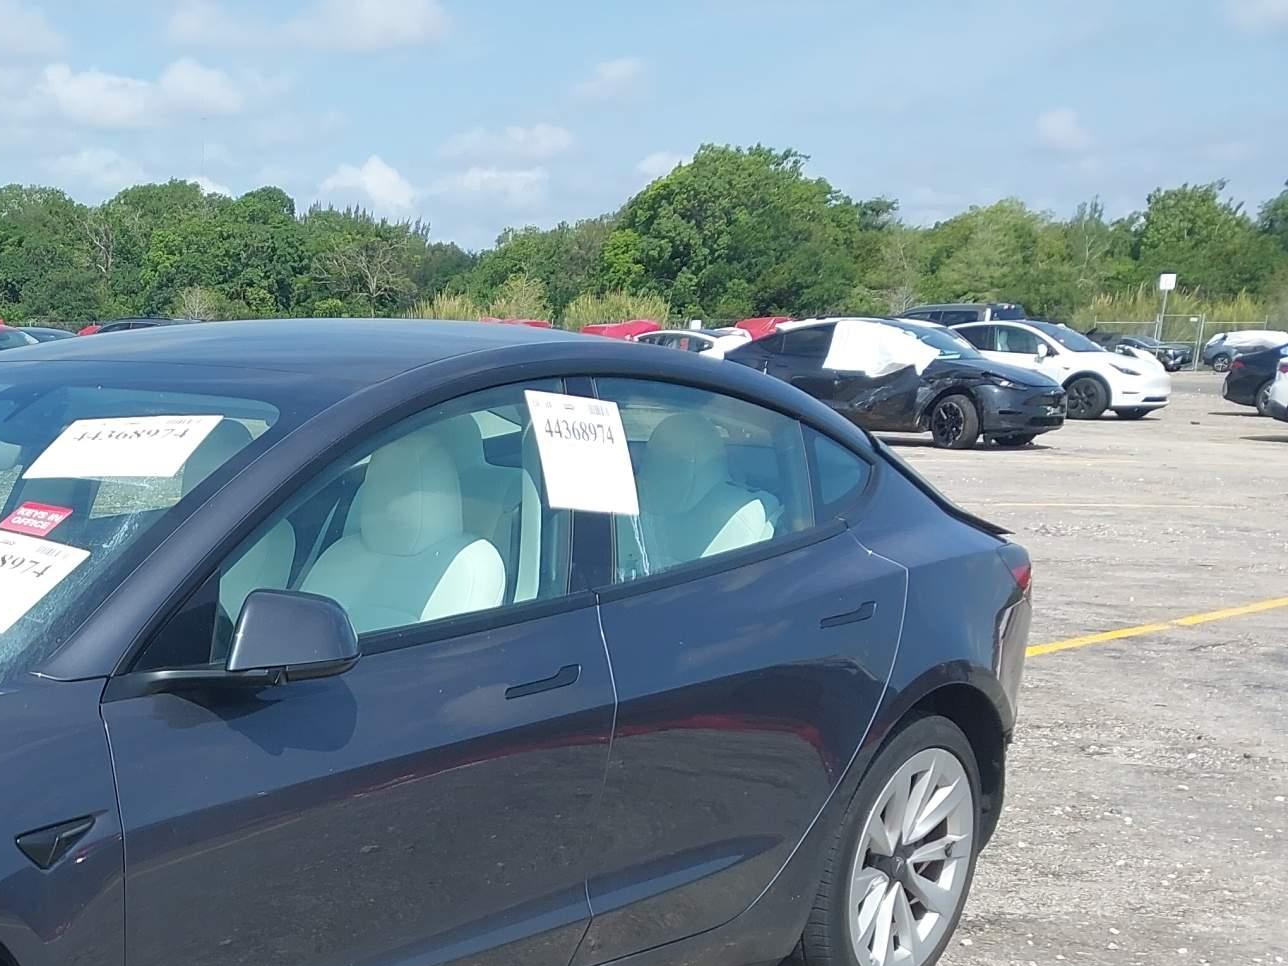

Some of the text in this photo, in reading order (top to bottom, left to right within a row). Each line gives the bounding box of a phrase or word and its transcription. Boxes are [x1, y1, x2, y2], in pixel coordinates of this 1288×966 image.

[73, 427, 190, 441] 44368974
[544, 417, 615, 445] 44368974
[17, 508, 63, 522] KEYS IN
[11, 516, 51, 529] OFFICE
